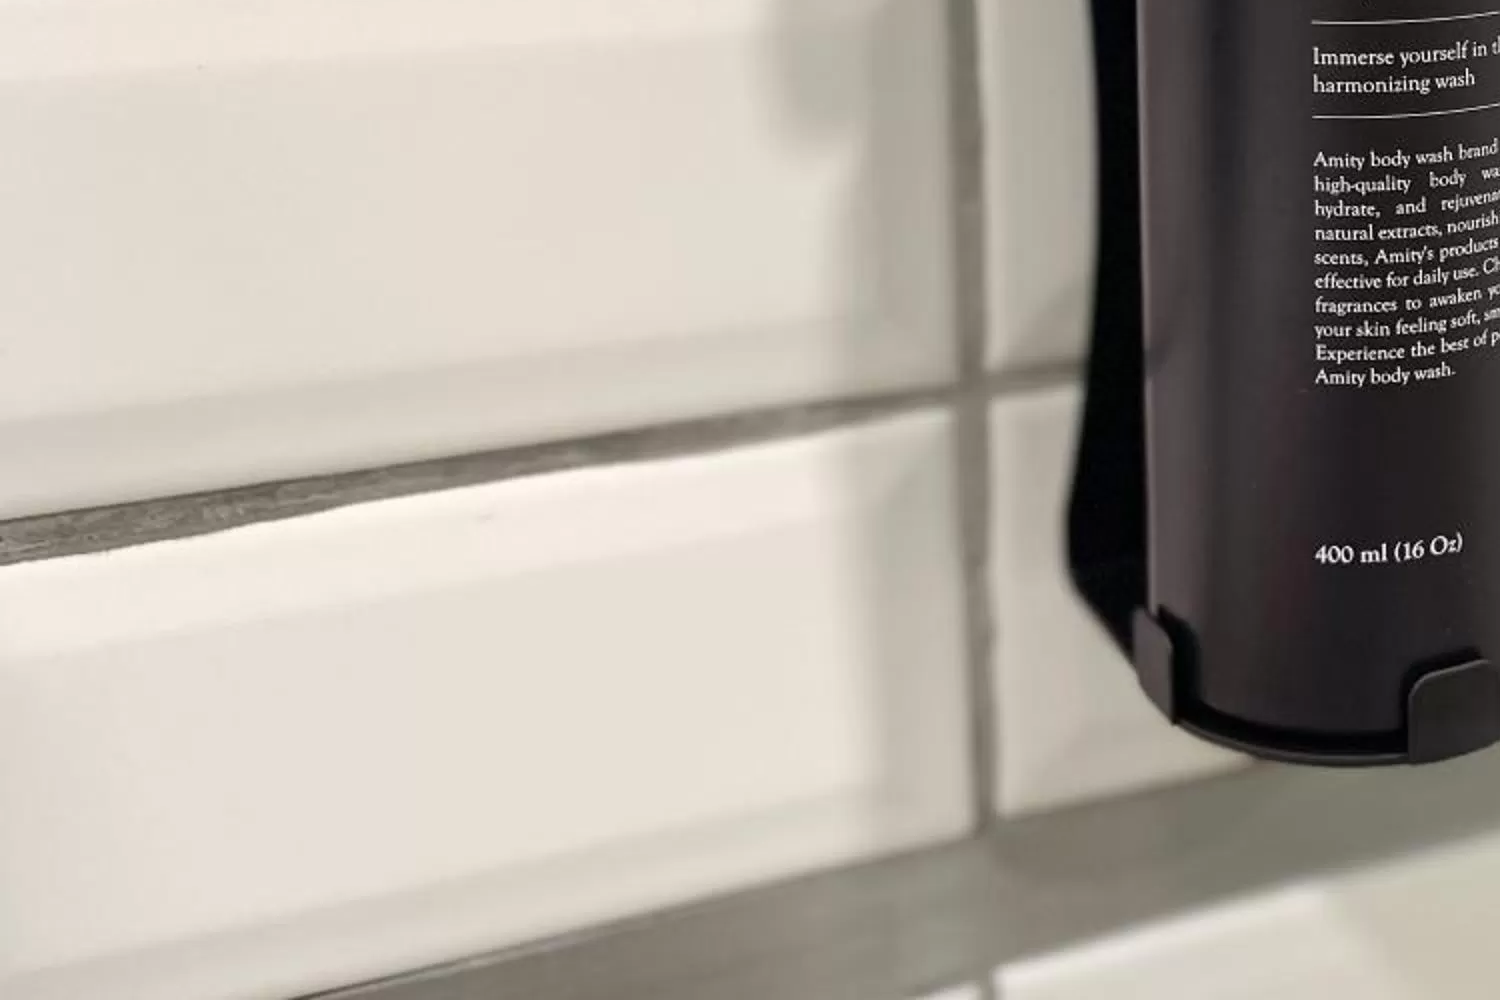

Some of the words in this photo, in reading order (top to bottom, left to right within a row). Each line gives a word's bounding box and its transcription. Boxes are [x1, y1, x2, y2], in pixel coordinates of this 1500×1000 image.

[1313, 48, 1394, 65] Immerse
[1400, 42, 1468, 68] yourself
[1472, 42, 1487, 56] in
[1313, 74, 1430, 94] harmonizing
[1435, 68, 1475, 88] wash
[1313, 151, 1365, 171] Amity
[1370, 150, 1411, 168] body
[1416, 146, 1453, 165] wash
[1459, 138, 1498, 160] brand
[1314, 176, 1411, 196] high-quality
[1430, 169, 1466, 188] body
[1315, 201, 1381, 219] hydrate,
[1396, 197, 1426, 215] and
[1315, 225, 1374, 241] natural
[1378, 223, 1443, 240] extracts,
[1314, 252, 1369, 267] scents,
[1375, 246, 1434, 266] Amity's
[1439, 237, 1498, 262] products
[1315, 274, 1382, 289] effective
[1386, 273, 1409, 288] for
[1414, 267, 1450, 286] daily
[1453, 268, 1479, 281] use.
[1315, 296, 1397, 316] fragrances
[1405, 297, 1422, 310] to
[1429, 289, 1482, 308] awaken
[1314, 324, 1351, 339] your
[1356, 322, 1390, 337] skin
[1396, 317, 1446, 336] feeling
[1450, 308, 1481, 329] soft,
[1315, 344, 1405, 365] Experience
[1411, 342, 1435, 358] the
[1441, 338, 1469, 355] best
[1474, 328, 1488, 347] of
[1315, 369, 1365, 388] Amity
[1370, 366, 1410, 385] body
[1414, 363, 1456, 381] wash.
[1315, 545, 1354, 564] 400
[1359, 542, 1388, 563] ml
[1394, 540, 1425, 562] (16
[1429, 531, 1463, 555] Oz)
